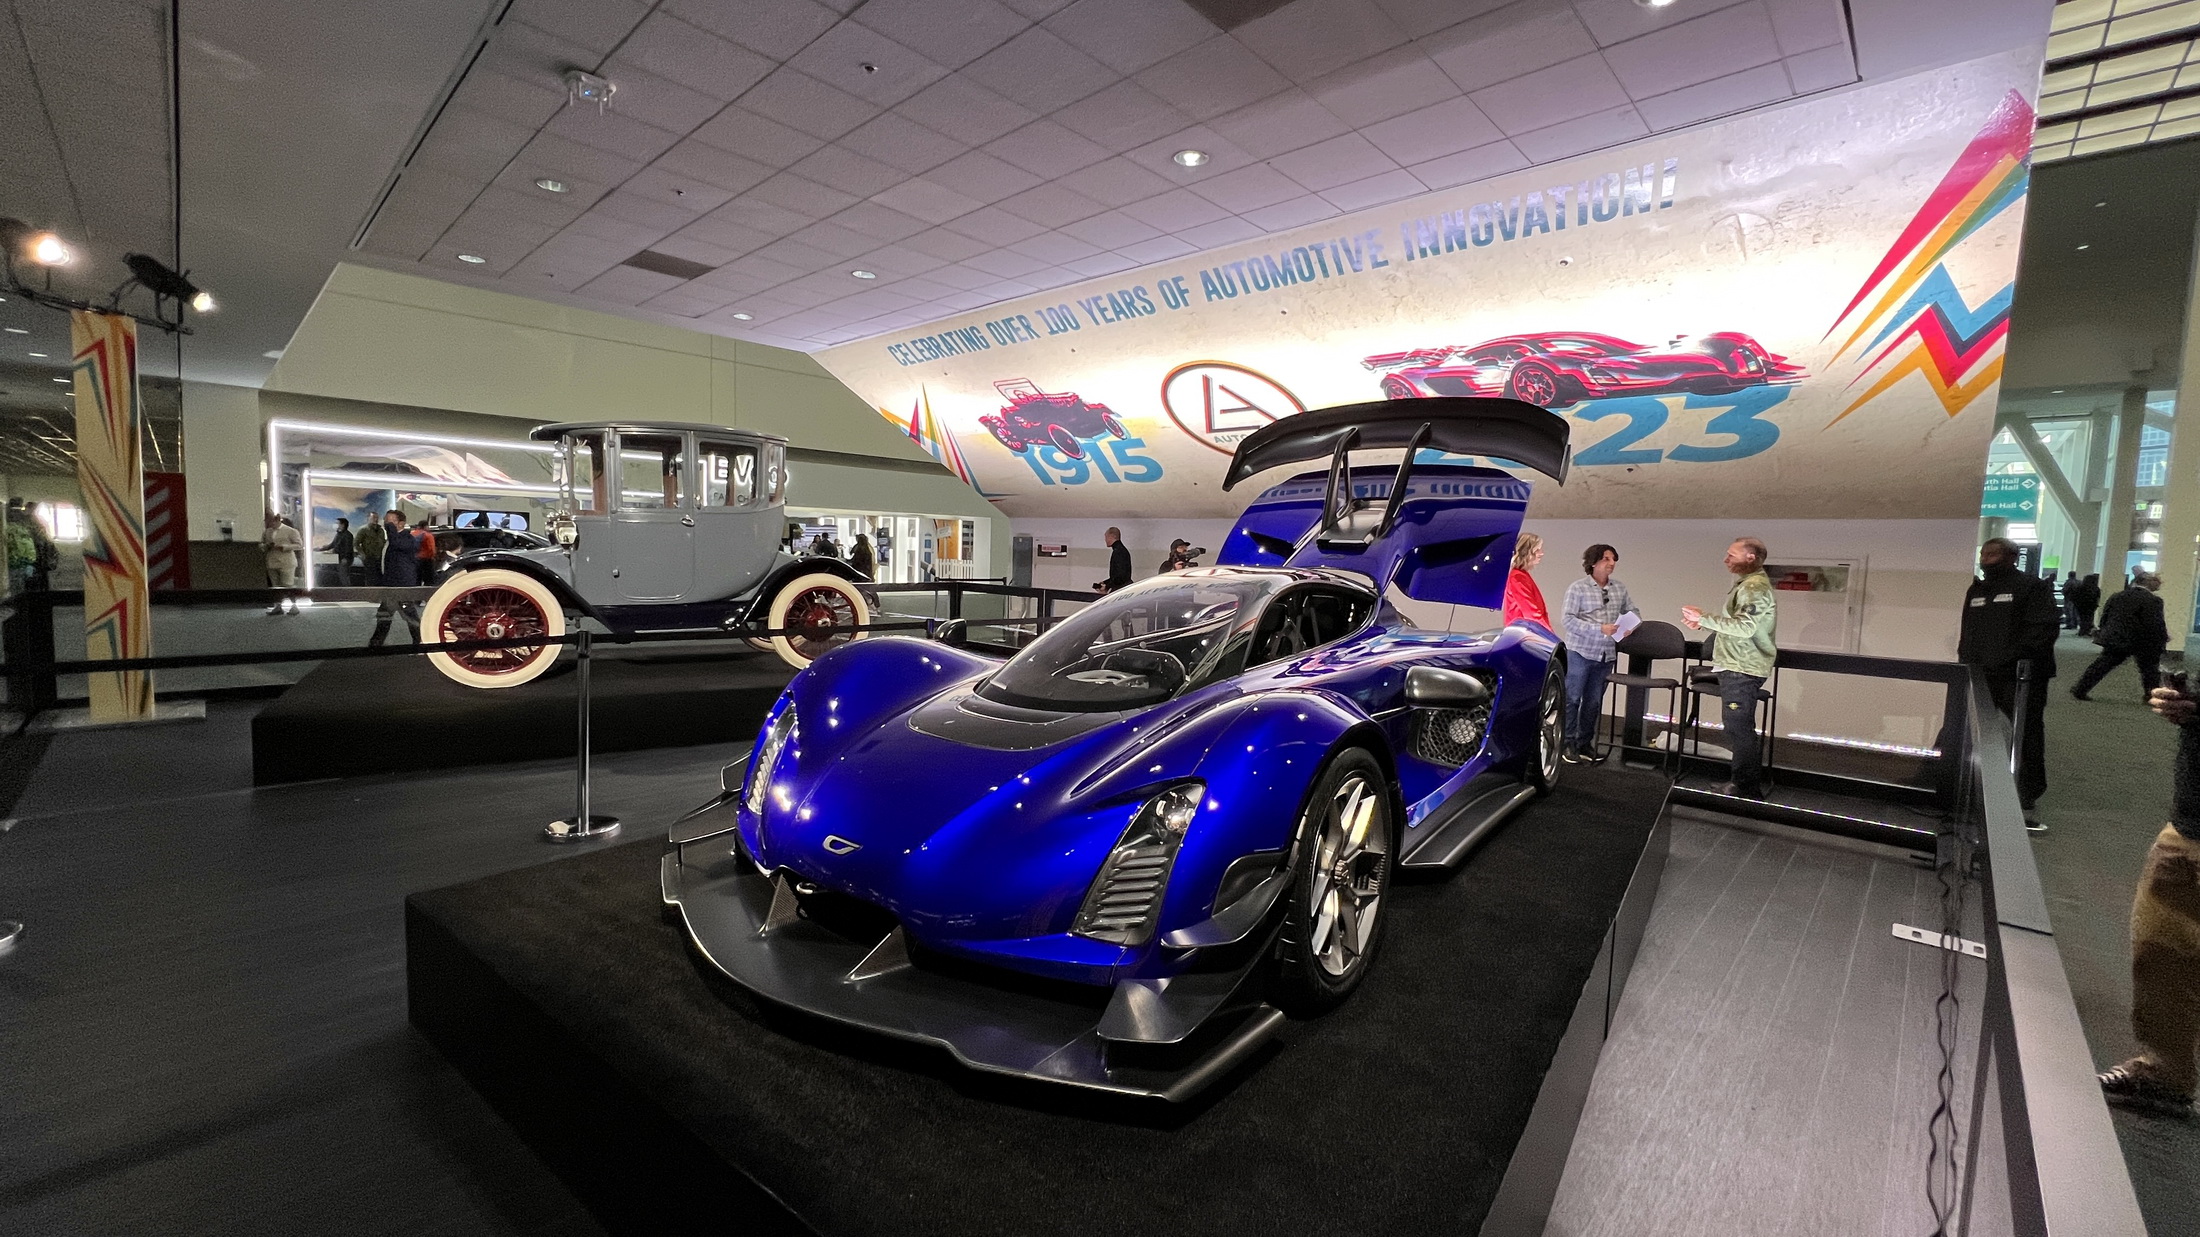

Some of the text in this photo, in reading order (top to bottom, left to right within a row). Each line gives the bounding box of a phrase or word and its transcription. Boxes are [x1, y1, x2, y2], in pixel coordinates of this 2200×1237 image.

[887, 156, 1680, 366] CELEBRATING OVER 100 YEARS OF AUTOMOTIVE INNOVATION!
[1010, 437, 1164, 486] 1915
[2001, 477, 2019, 485] Hall
